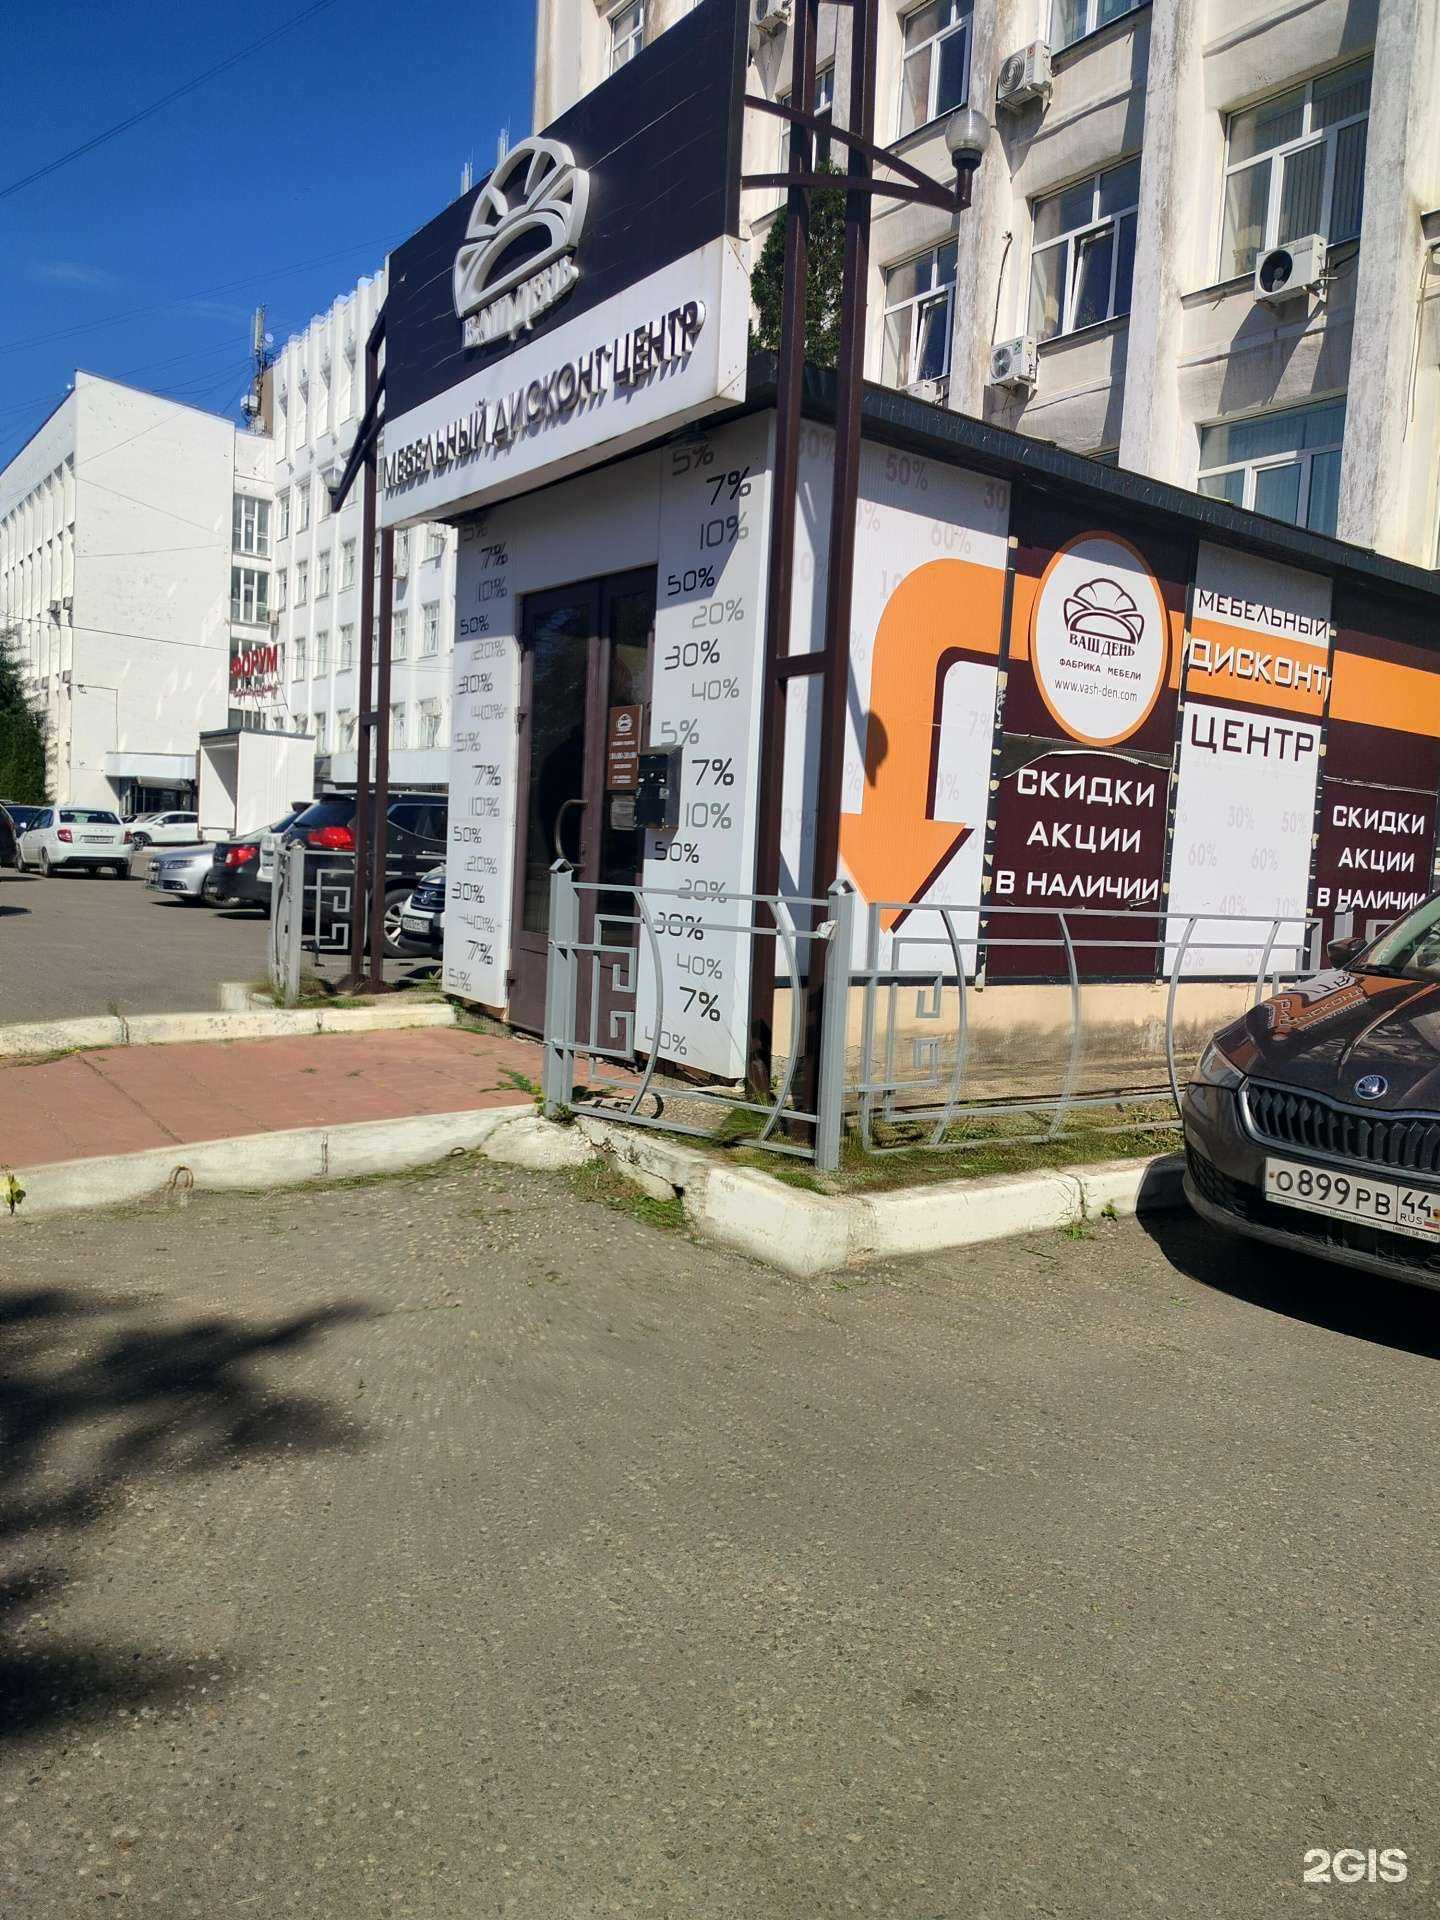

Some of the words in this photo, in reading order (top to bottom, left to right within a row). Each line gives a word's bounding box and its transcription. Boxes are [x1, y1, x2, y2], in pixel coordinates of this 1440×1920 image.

[384, 398, 488, 490] МЕБЕЛЬНЫЙ
[491, 345, 613, 450] ДИСКОНТ
[613, 300, 706, 388] ЦЕНТР
[672, 444, 715, 477] 5%
[706, 466, 752, 505] 7%
[699, 511, 749, 550] 10%
[481, 542, 508, 570] 7%
[477, 576, 507, 602] 10%
[667, 565, 715, 596] 50%
[460, 615, 489, 636] 50%
[691, 598, 744, 629] 20%
[1198, 589, 1328, 639] МЕБЕЛЬНЫЙ
[471, 639, 506, 661] 20%
[664, 638, 720, 671] 30%
[1069, 633, 1100, 656] ВАШ
[1101, 640, 1136, 659] ДЕНЬ
[231, 643, 278, 678] ФОРУМ
[1059, 657, 1101, 673] ФАБРИКА
[1107, 667, 1142, 681] МЕБЕЛИ
[1187, 637, 1327, 696] ДИСКОНТ
[457, 672, 494, 696] 30%
[691, 677, 740, 702] 40%
[1054, 678, 1138, 702] www.vash-den.com
[472, 703, 506, 721] 40%
[454, 732, 481, 753] 5%
[661, 718, 700, 746] 5%
[1191, 714, 1314, 762] ЦЕНТР
[472, 764, 501, 786] 7%
[691, 758, 735, 786] 7%
[1017, 768, 1155, 808] СКИДКИ
[469, 797, 500, 817] 10%
[686, 802, 732, 829] 10%
[1332, 805, 1425, 836] СКИДКИ
[453, 827, 482, 844] 50%
[1026, 821, 1141, 854] АКЦИИ
[465, 856, 498, 874] 20%
[654, 841, 700, 864] 50%
[1338, 847, 1415, 873] АКЦИИ
[451, 882, 485, 903] 30%
[677, 878, 728, 904] 20%
[995, 870, 1015, 894] В
[1026, 871, 1159, 901] НАЛИЧИИ
[1317, 887, 1331, 907] В
[464, 915, 496, 933] 40%
[466, 940, 494, 965] 7%
[677, 952, 723, 980] 40%
[448, 968, 472, 992] 5%
[679, 986, 721, 1022] 7%
[1401, 1191, 1431, 1217] 44
[1400, 1212, 1423, 1227] RUS
